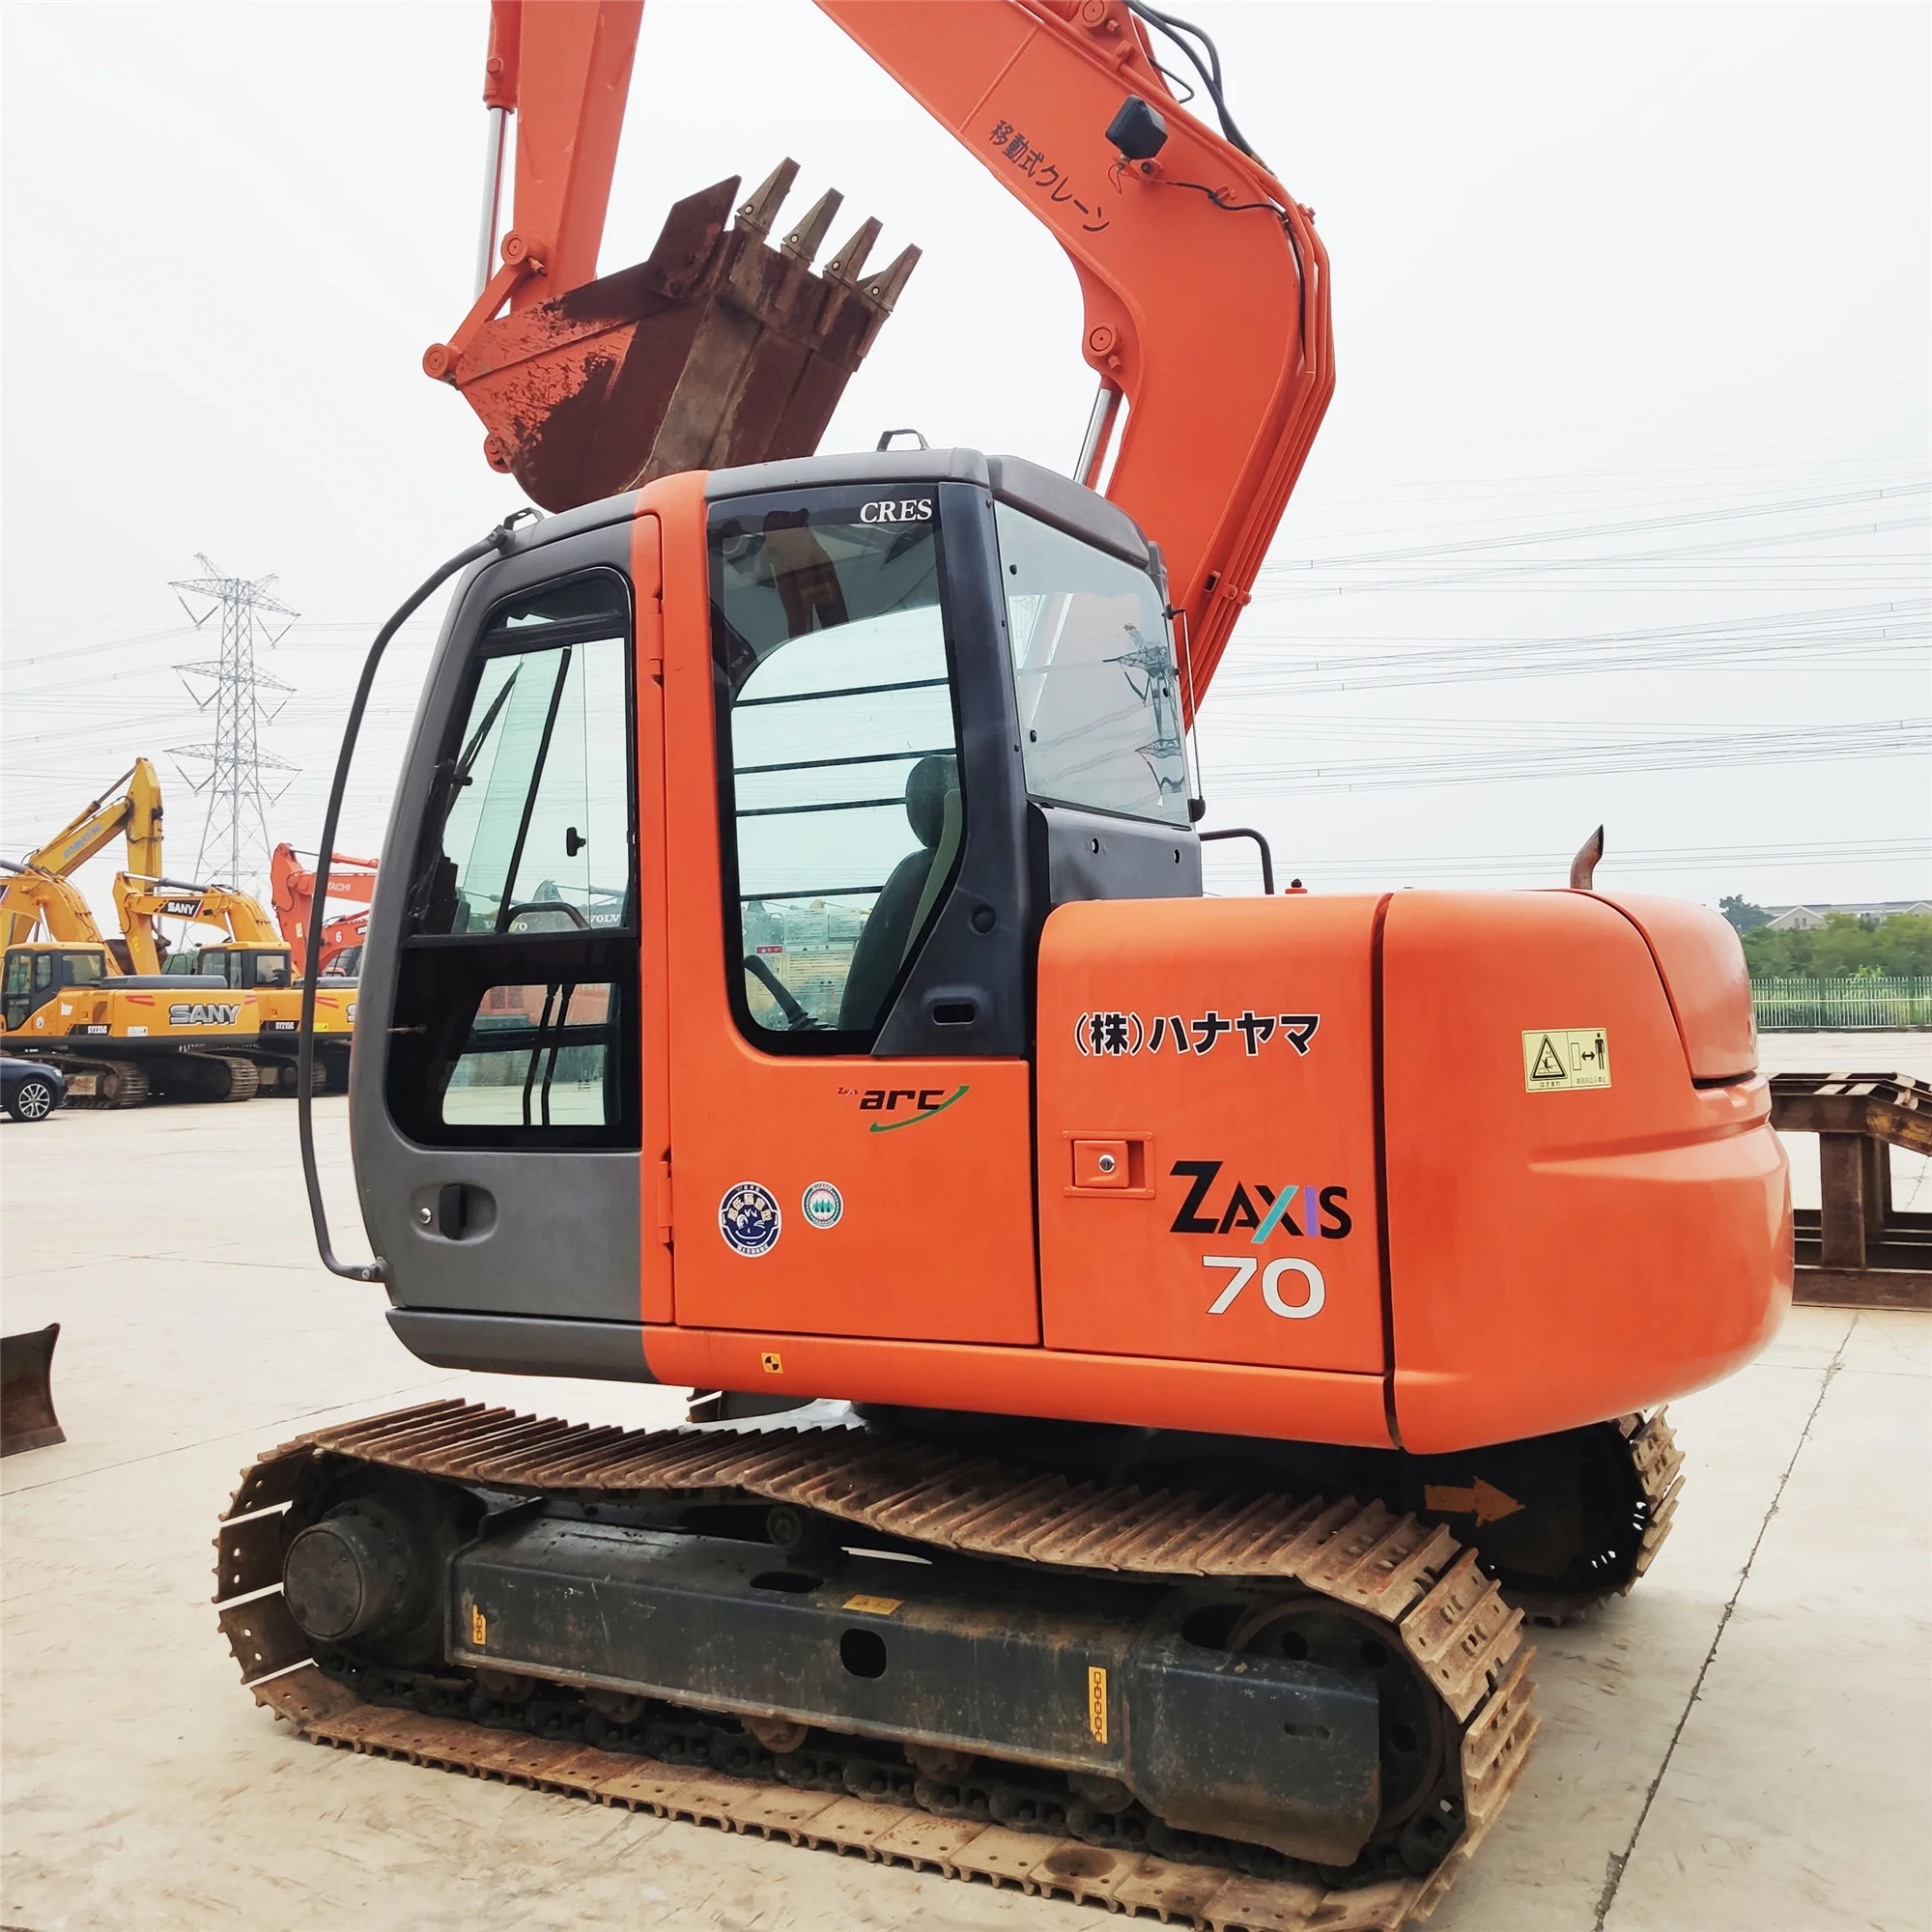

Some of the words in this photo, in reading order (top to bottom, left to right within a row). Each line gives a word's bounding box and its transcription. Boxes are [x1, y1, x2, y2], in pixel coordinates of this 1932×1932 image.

[989, 120, 1110, 232] 移動式クレーン
[860, 498, 933, 523] CRES
[328, 881, 352, 892] TACHI
[167, 901, 195, 915] SANY
[585, 913, 621, 923] VOLV
[335, 930, 342, 943] 6
[169, 1004, 241, 1026] SANY
[1074, 1010, 1321, 1057] (株)ハナヤマ
[859, 1089, 946, 1111] arc
[1169, 1160, 1352, 1244] ZAXIS
[1202, 1255, 1326, 1320] 70
